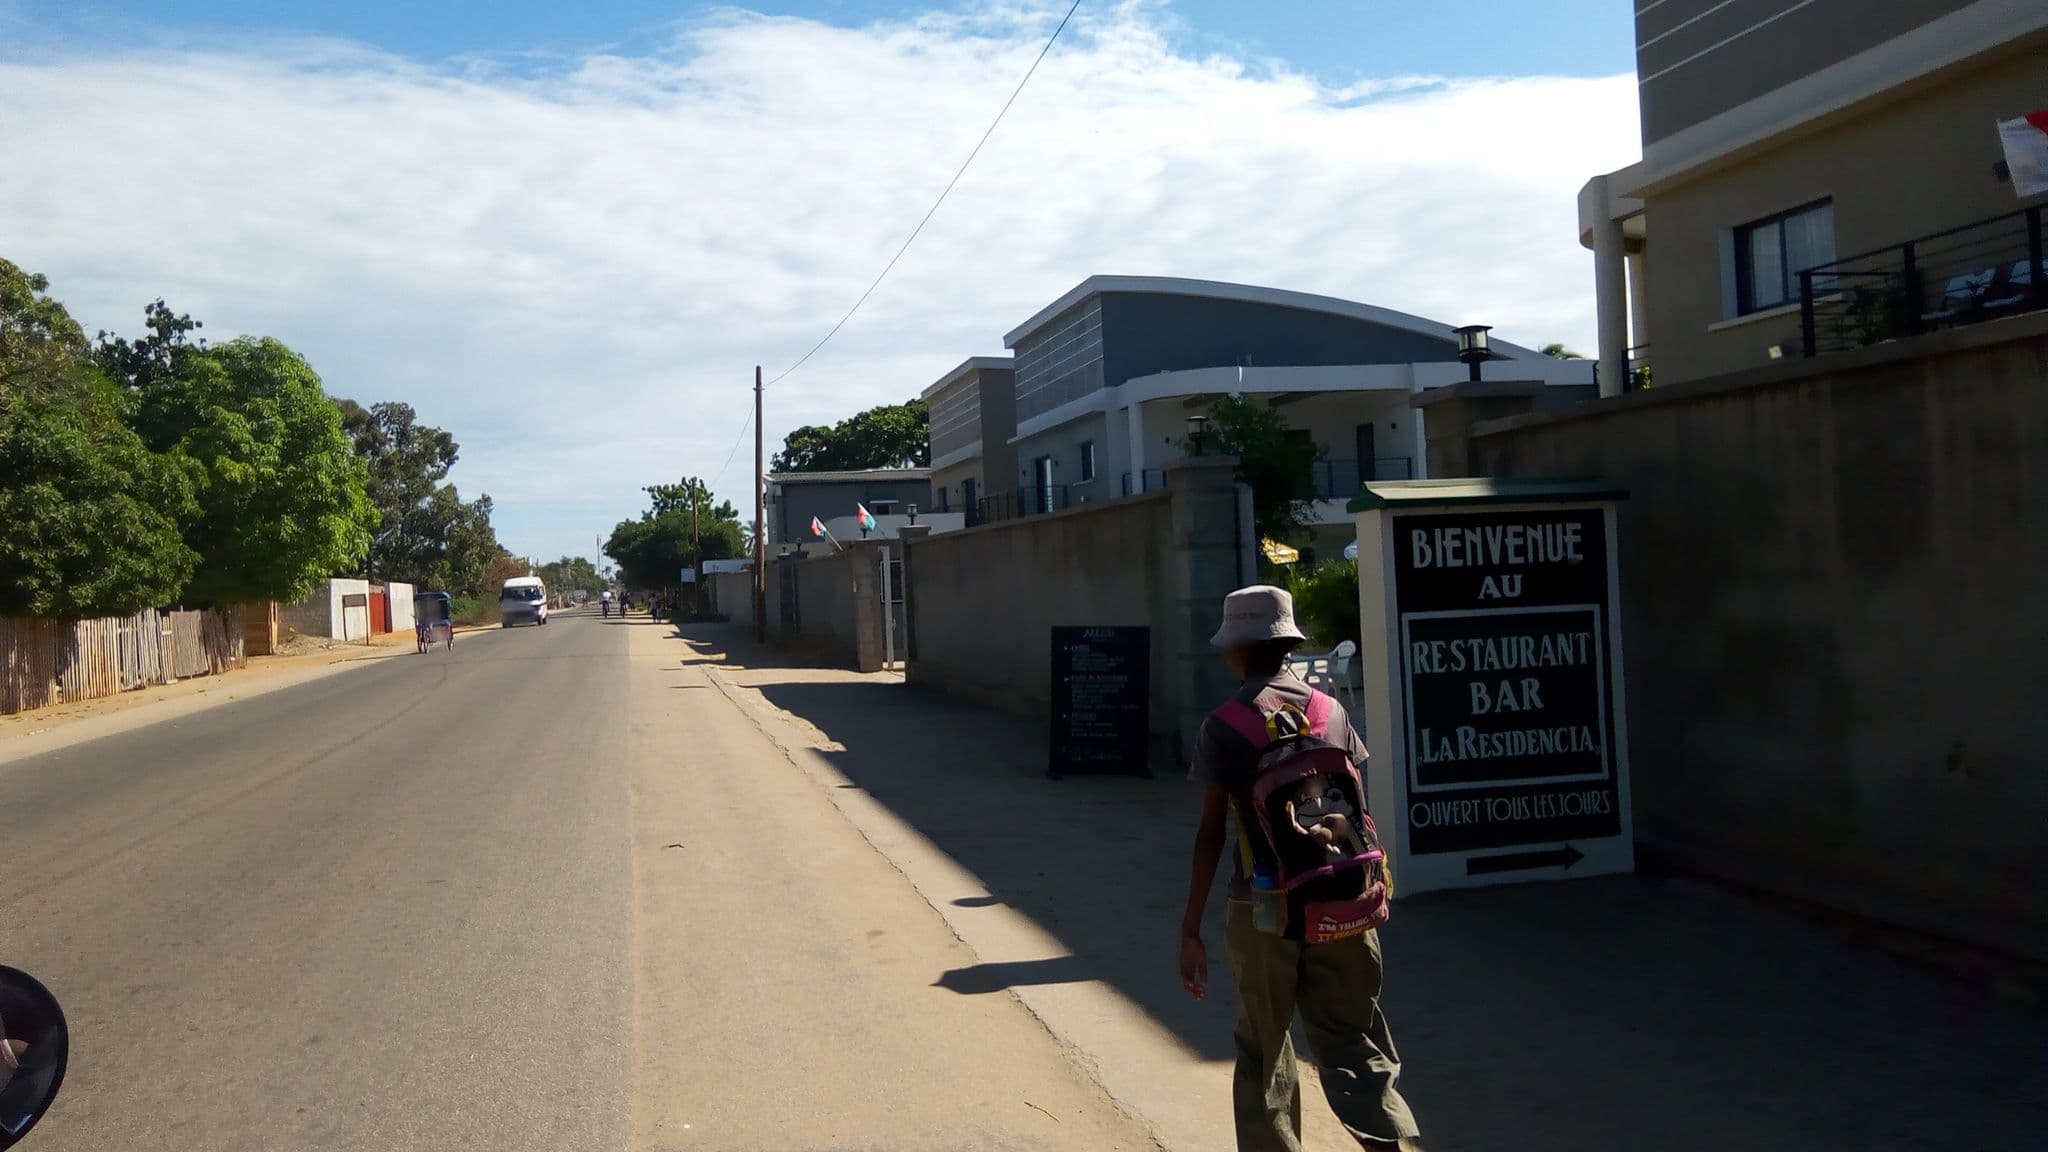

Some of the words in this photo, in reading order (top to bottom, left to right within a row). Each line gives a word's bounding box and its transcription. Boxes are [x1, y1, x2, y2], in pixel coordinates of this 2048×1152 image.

[1411, 522, 1584, 569] BIENVENUE
[1477, 573, 1523, 600] AU
[1411, 632, 1591, 674] RESTAURANT
[1468, 677, 1544, 716] BAR
[1410, 801, 1480, 828] OUVERT
[1484, 797, 1530, 822] TOUS
[1533, 792, 1556, 819] LES
[1557, 790, 1611, 817] JOURS
